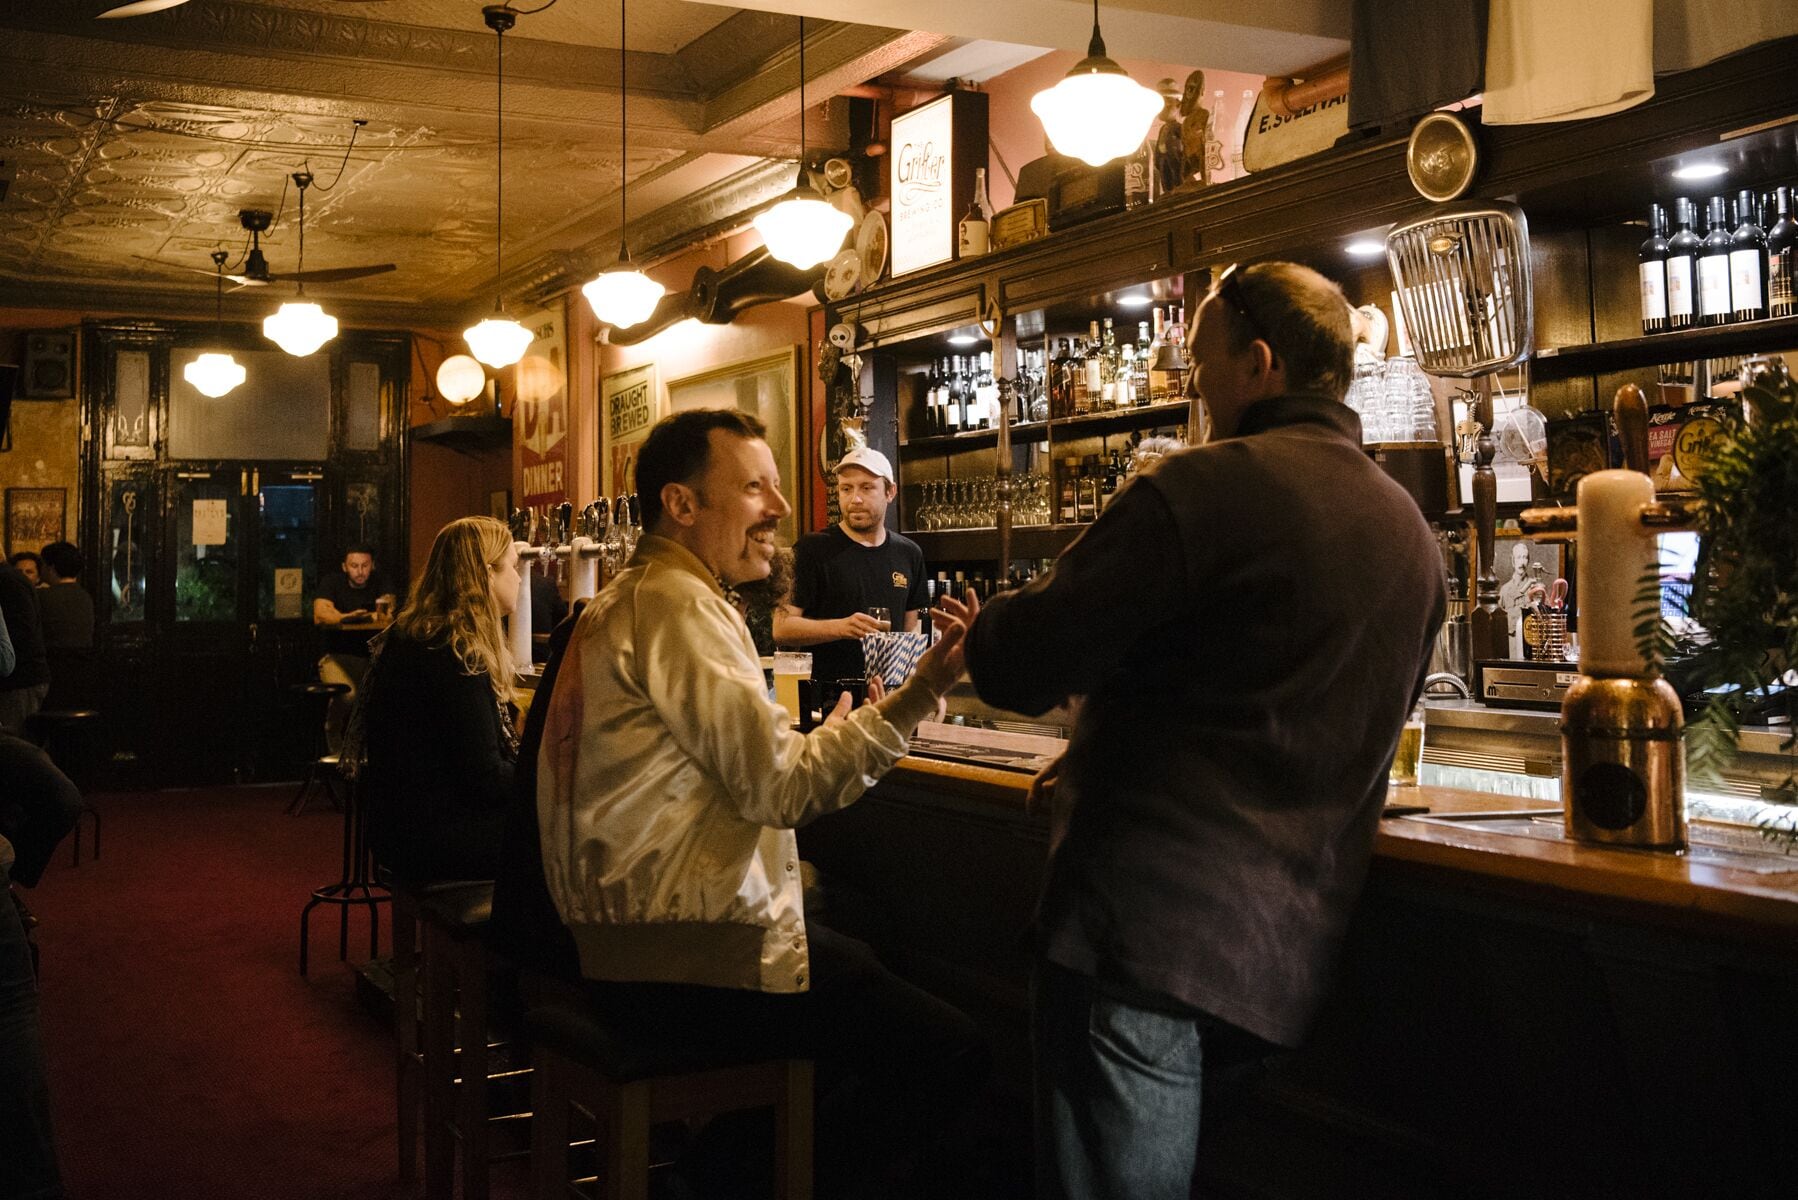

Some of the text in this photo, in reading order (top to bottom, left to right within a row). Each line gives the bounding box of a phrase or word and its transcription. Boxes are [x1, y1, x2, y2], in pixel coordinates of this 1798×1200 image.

[610, 384, 648, 417] DRAUGHT
[610, 405, 649, 437] BREWED
[1648, 428, 1677, 441] EA SALT
[523, 461, 564, 497] DINNER
